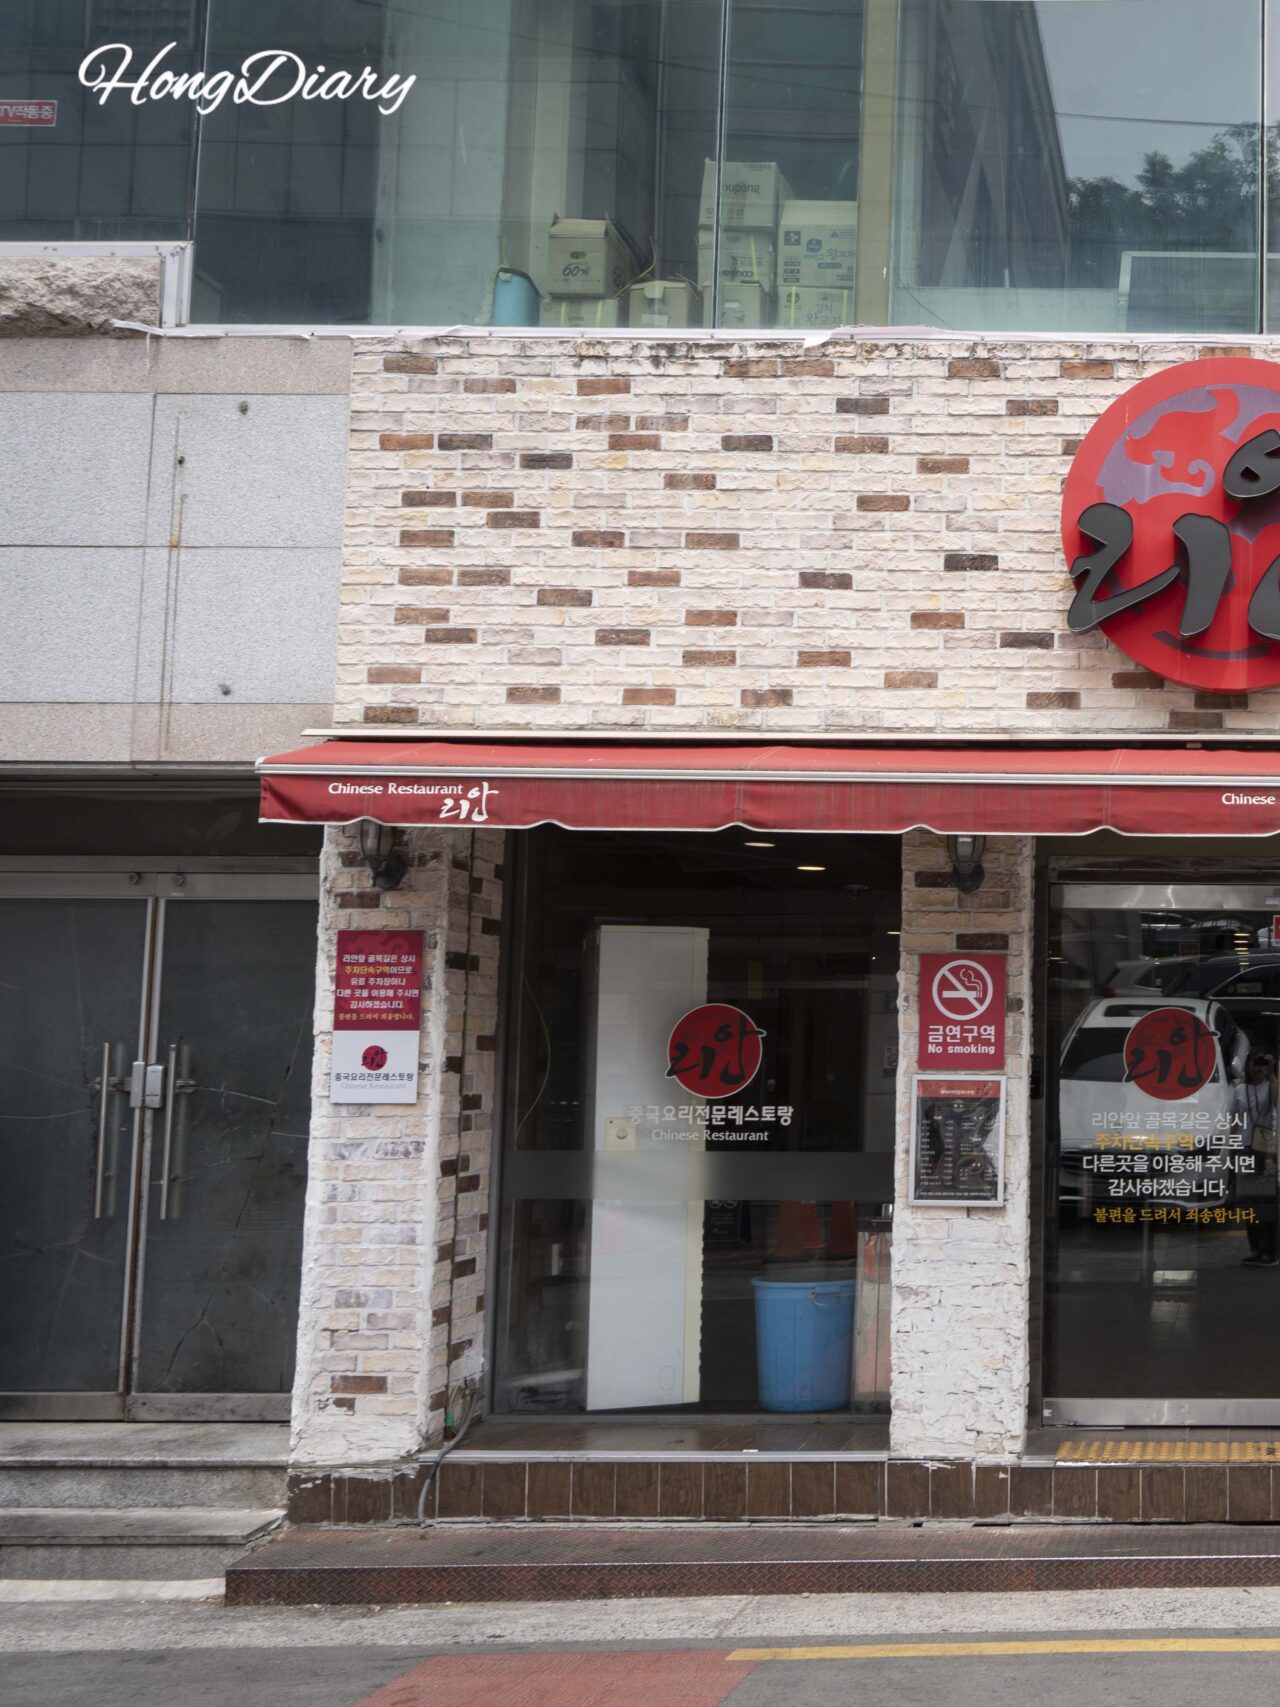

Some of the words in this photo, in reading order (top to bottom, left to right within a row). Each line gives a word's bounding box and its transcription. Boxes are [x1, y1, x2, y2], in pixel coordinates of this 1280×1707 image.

[328, 783, 383, 794] Chinese
[388, 783, 463, 794] Restaurant
[439, 782, 499, 821] 리안
[1222, 793, 1276, 805] Chinese
[928, 1025, 995, 1042] 금연구역
[928, 1044, 942, 1053] No
[947, 1044, 995, 1054] smoking
[628, 1105, 794, 1125] 중국요리전문레스토랑
[1092, 1112, 1142, 1129] 리안앞
[1144, 1112, 1210, 1129] 골목길은
[1214, 1112, 1247, 1129] 상시
[651, 1129, 699, 1141] Chinese
[703, 1129, 768, 1141] Restaurant
[1094, 1133, 1244, 1151] 주차단속구역이므로
[1153, 1154, 1203, 1173] 이용해
[1205, 1154, 1255, 1173] 주시면
[1108, 1179, 1229, 1196] 감사하겠습니다.
[1093, 1208, 1137, 1223] 불편을
[1139, 1208, 1181, 1223] 드려서
[1185, 1208, 1260, 1224] 죄송합니다.
